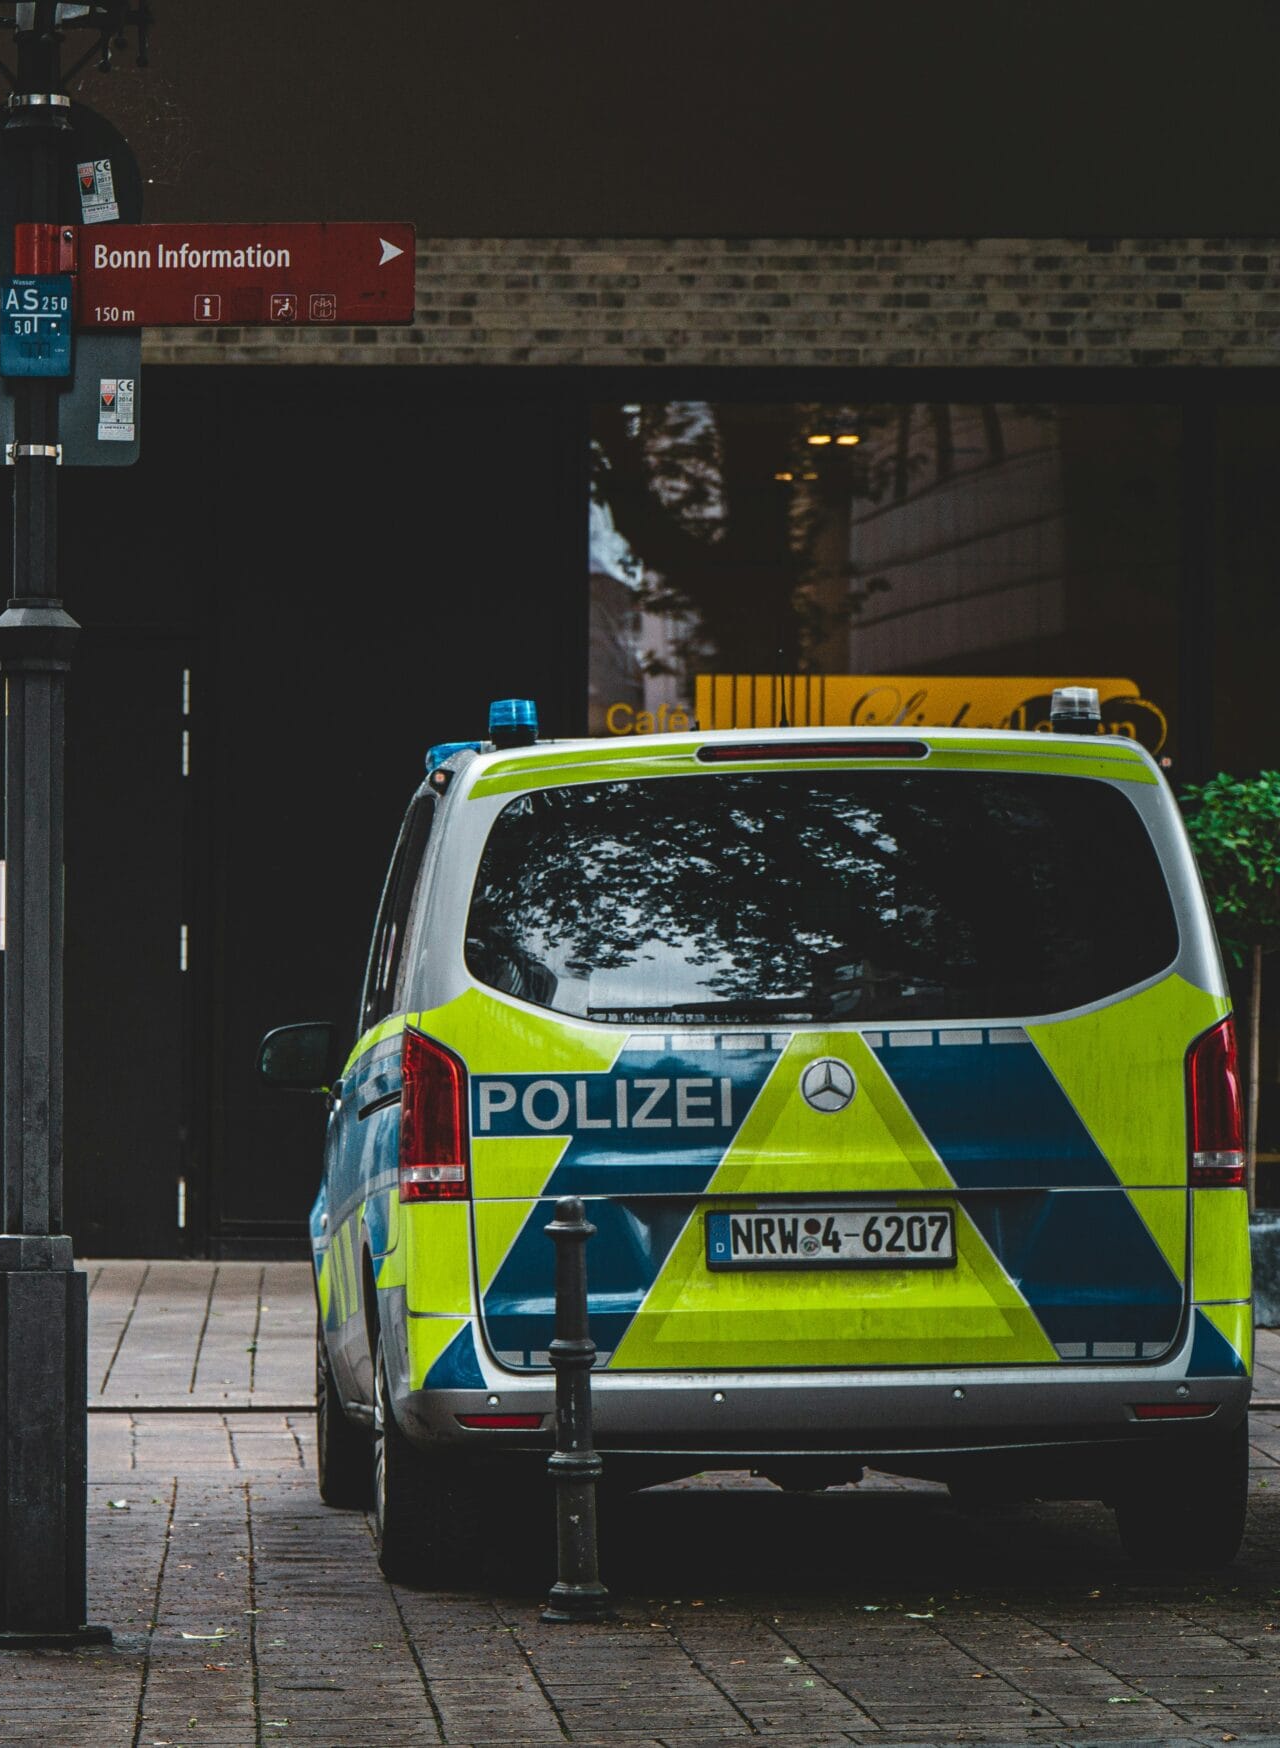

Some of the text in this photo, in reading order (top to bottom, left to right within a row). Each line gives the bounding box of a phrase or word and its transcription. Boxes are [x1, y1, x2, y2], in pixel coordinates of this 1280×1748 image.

[94, 242, 291, 270] Bonn Information
[5, 288, 68, 311] AS 250
[94, 306, 136, 322] 150 m
[14, 319, 32, 337] 5,0
[606, 702, 689, 737] Café
[478, 1076, 734, 1131] POLIZEI
[715, 1242, 725, 1254] D
[731, 1215, 949, 1256] NRW 4-6207
